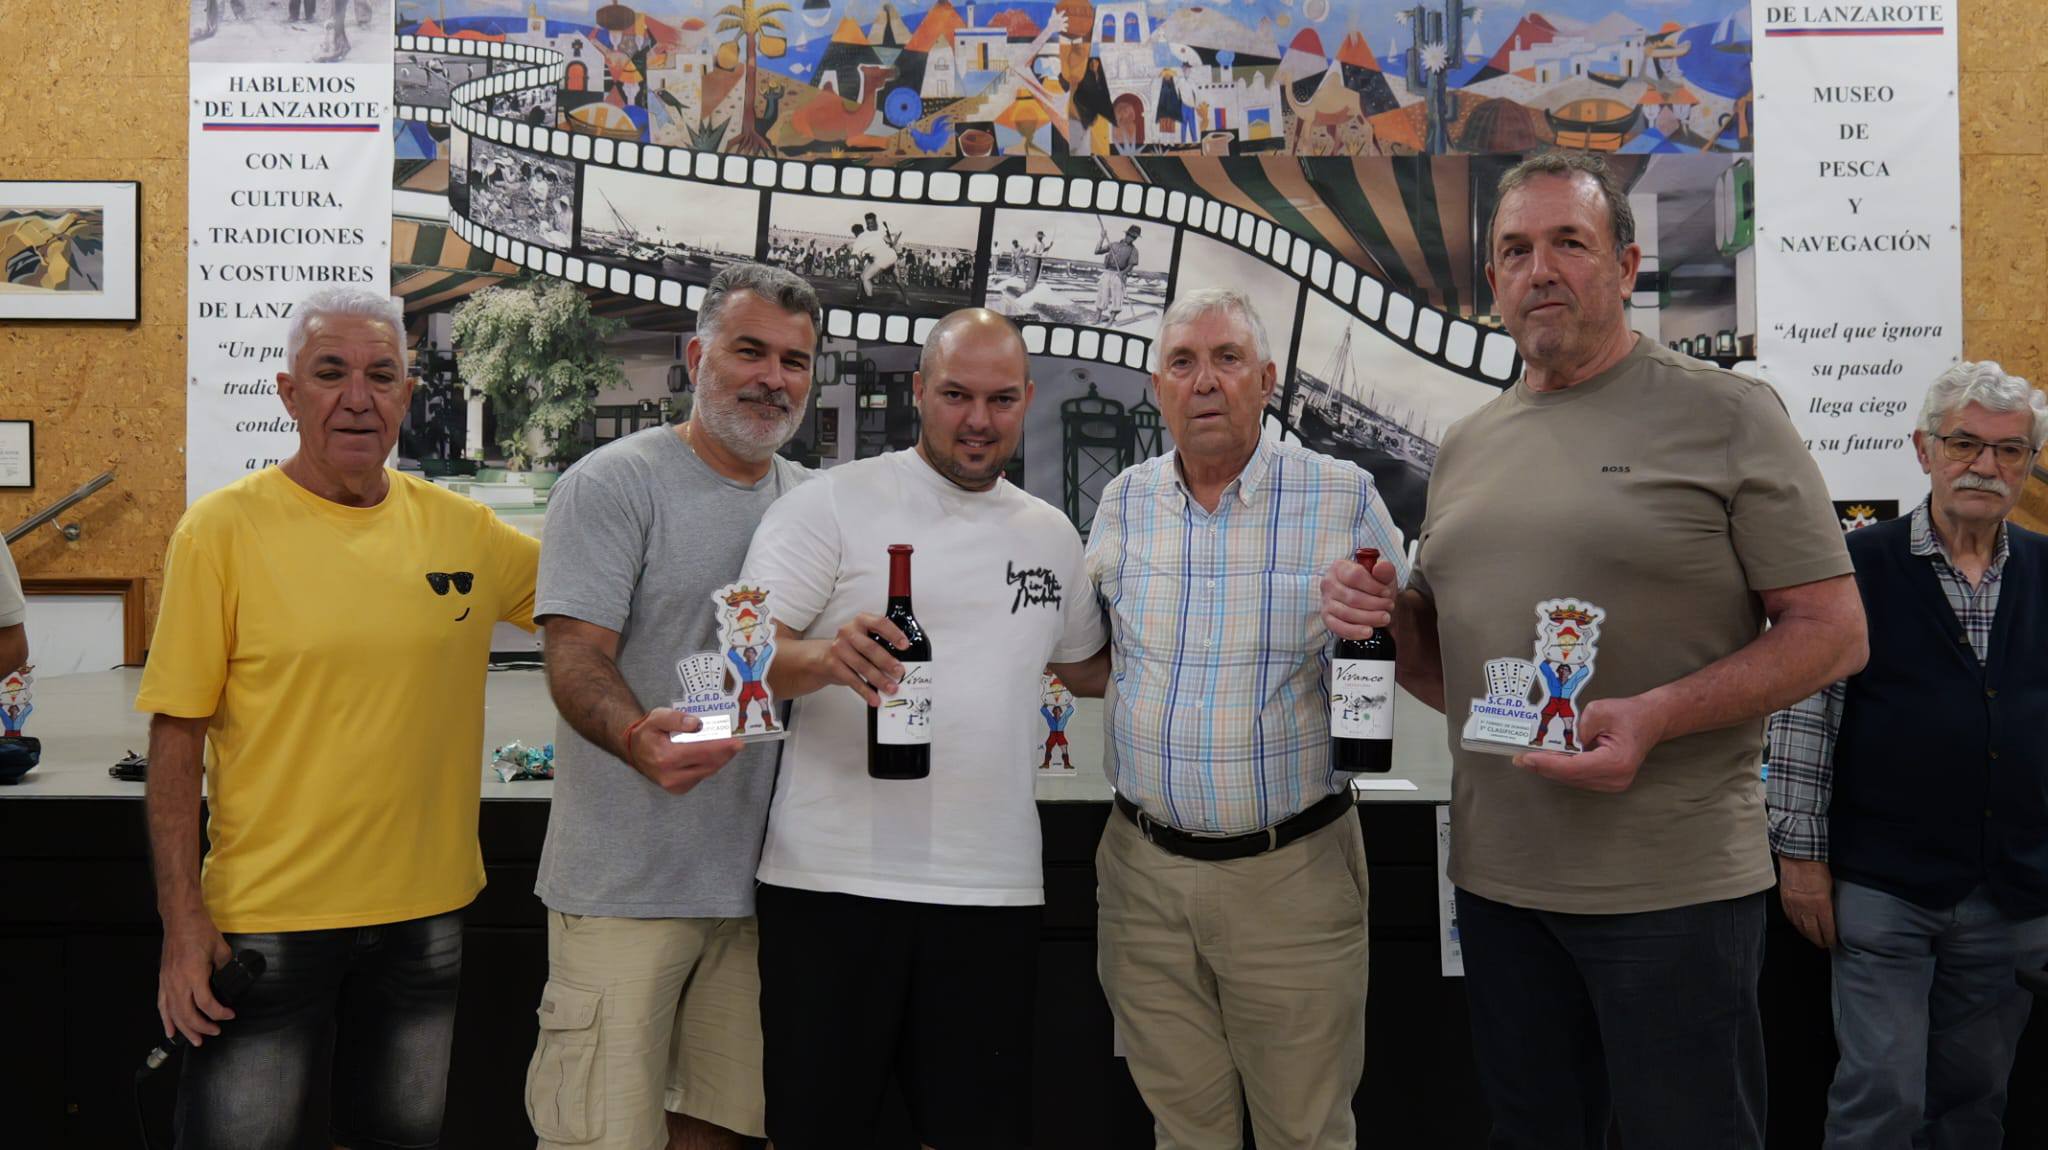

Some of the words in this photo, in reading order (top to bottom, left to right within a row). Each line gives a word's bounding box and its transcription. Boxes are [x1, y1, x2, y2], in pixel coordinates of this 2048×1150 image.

[1767, 7, 1797, 23] DE
[1804, 5, 1944, 23] LANZAROTE
[229, 76, 356, 93] HABLEMOS
[1813, 85, 1894, 103] MUSEO
[205, 101, 233, 117] DE
[241, 102, 380, 118] LANZAROTE
[1839, 123, 1869, 140] DE
[246, 153, 293, 170] CON
[301, 154, 329, 170] LA
[1819, 160, 1890, 177] PESCA
[231, 190, 343, 210] CULTURA,
[1848, 198, 1863, 214] Y
[209, 227, 364, 245] TRADICIONES
[1780, 230, 1931, 252] NAVEGACIÓN
[200, 265, 213, 281] Y
[220, 265, 374, 282] COSTUMBRES
[199, 302, 228, 318] DE
[236, 302, 294, 318] LANZ
[1774, 322, 1839, 343] “Aquel
[1843, 327, 1876, 343] que
[1882, 322, 1943, 341] ignora
[218, 341, 255, 358] “Un
[259, 347, 286, 362] pu
[1812, 361, 1833, 376] su
[1837, 359, 1903, 380] pasado
[224, 379, 280, 395] tradic
[1809, 397, 1853, 416] llega
[1859, 397, 1907, 416] ciego
[236, 416, 300, 432] conden
[1819, 439, 1839, 450] su
[246, 458, 256, 469] a
[1602, 465, 1631, 473] BOSS
[1336, 663, 1384, 683] Vivanco
[687, 692, 722, 703] S.C.R.D.
[1488, 696, 1526, 709] S.C.R.D.
[1473, 704, 1539, 720] TORRELAVEGA
[1487, 726, 1530, 738] CLASIFICADO
